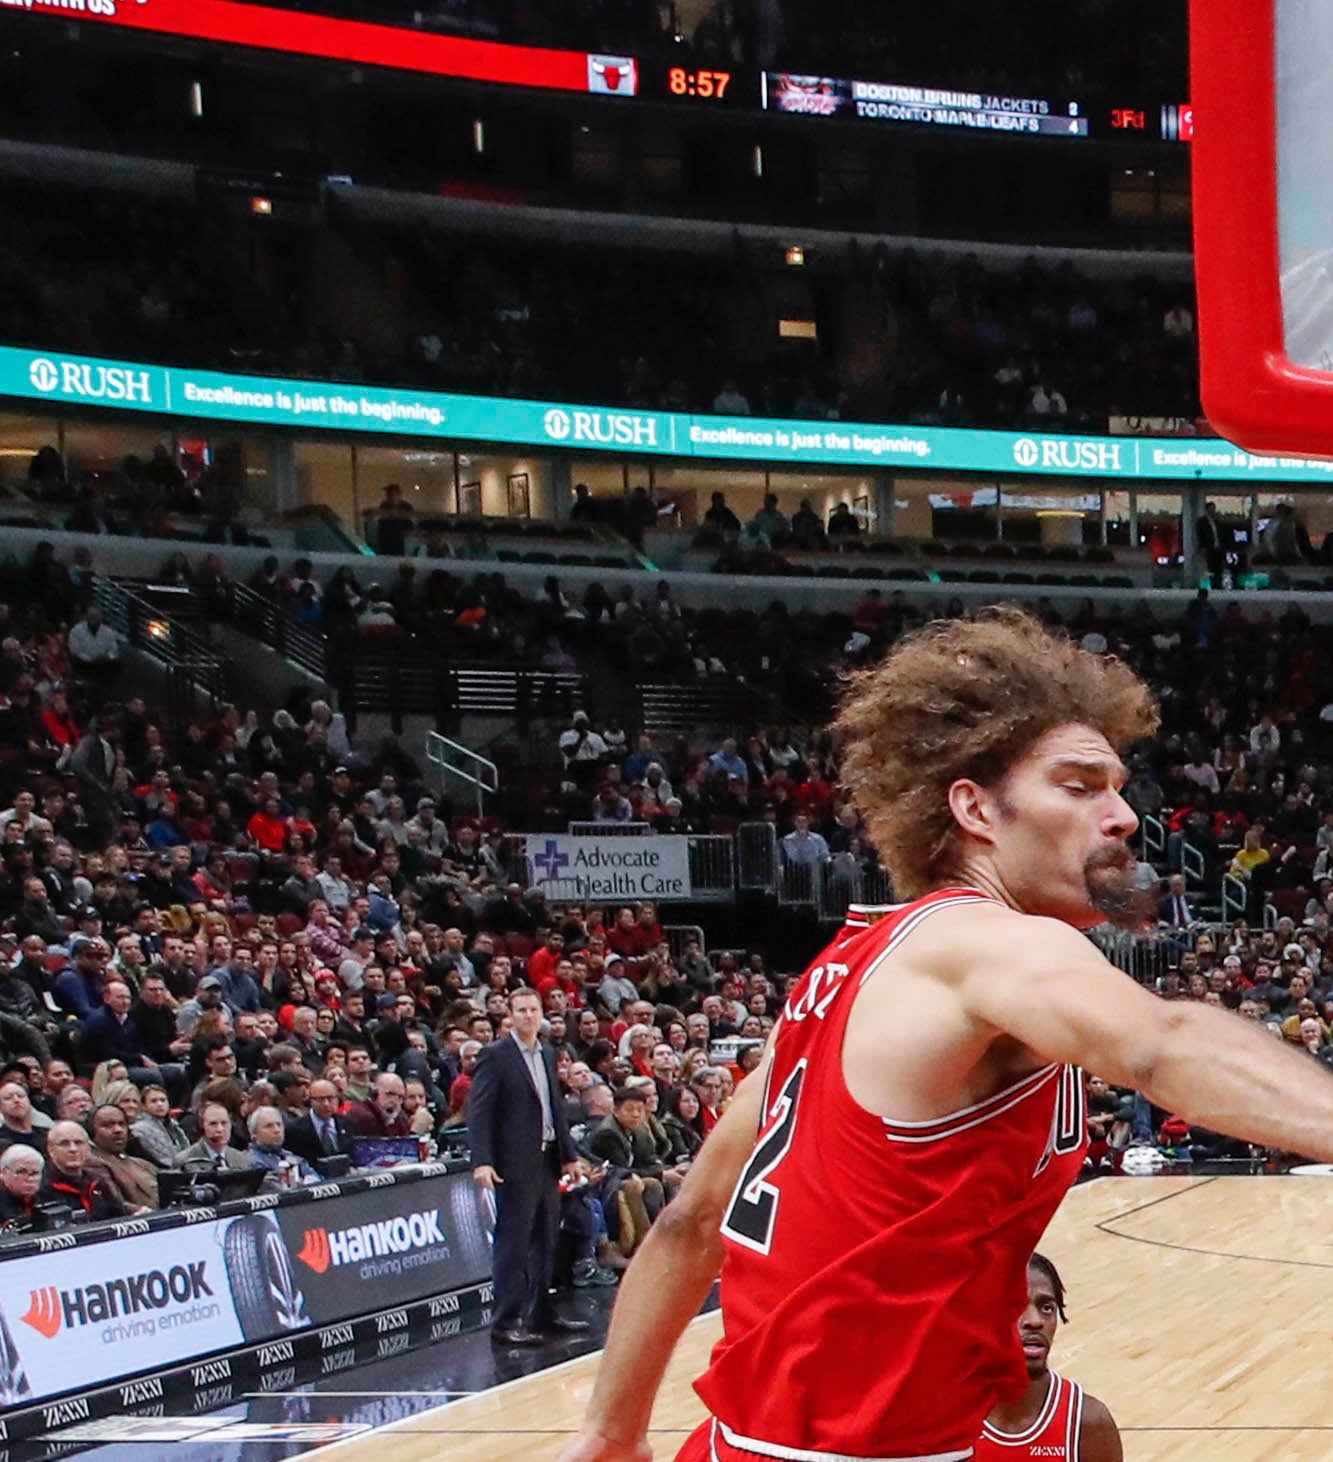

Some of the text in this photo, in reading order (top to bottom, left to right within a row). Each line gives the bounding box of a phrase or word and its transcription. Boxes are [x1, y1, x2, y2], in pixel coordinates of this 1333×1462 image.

[669, 68, 730, 99] 8:57
[856, 101, 930, 122] TORONTO
[990, 115, 1039, 132] LEAFS
[62, 361, 446, 425] RUSH Excellence is just the beginning.
[573, 411, 931, 457] RUSH Excellence is just the beginning.
[1041, 440, 1120, 470] RUSH
[1153, 450, 1231, 467] Excellence
[574, 846, 660, 868] Advocate
[576, 872, 682, 893] Health Care
[360, 1247, 450, 1280] driving emotion
[101, 1302, 221, 1345] driving emotion
[1030, 1446, 1066, 1457] ZENNI
